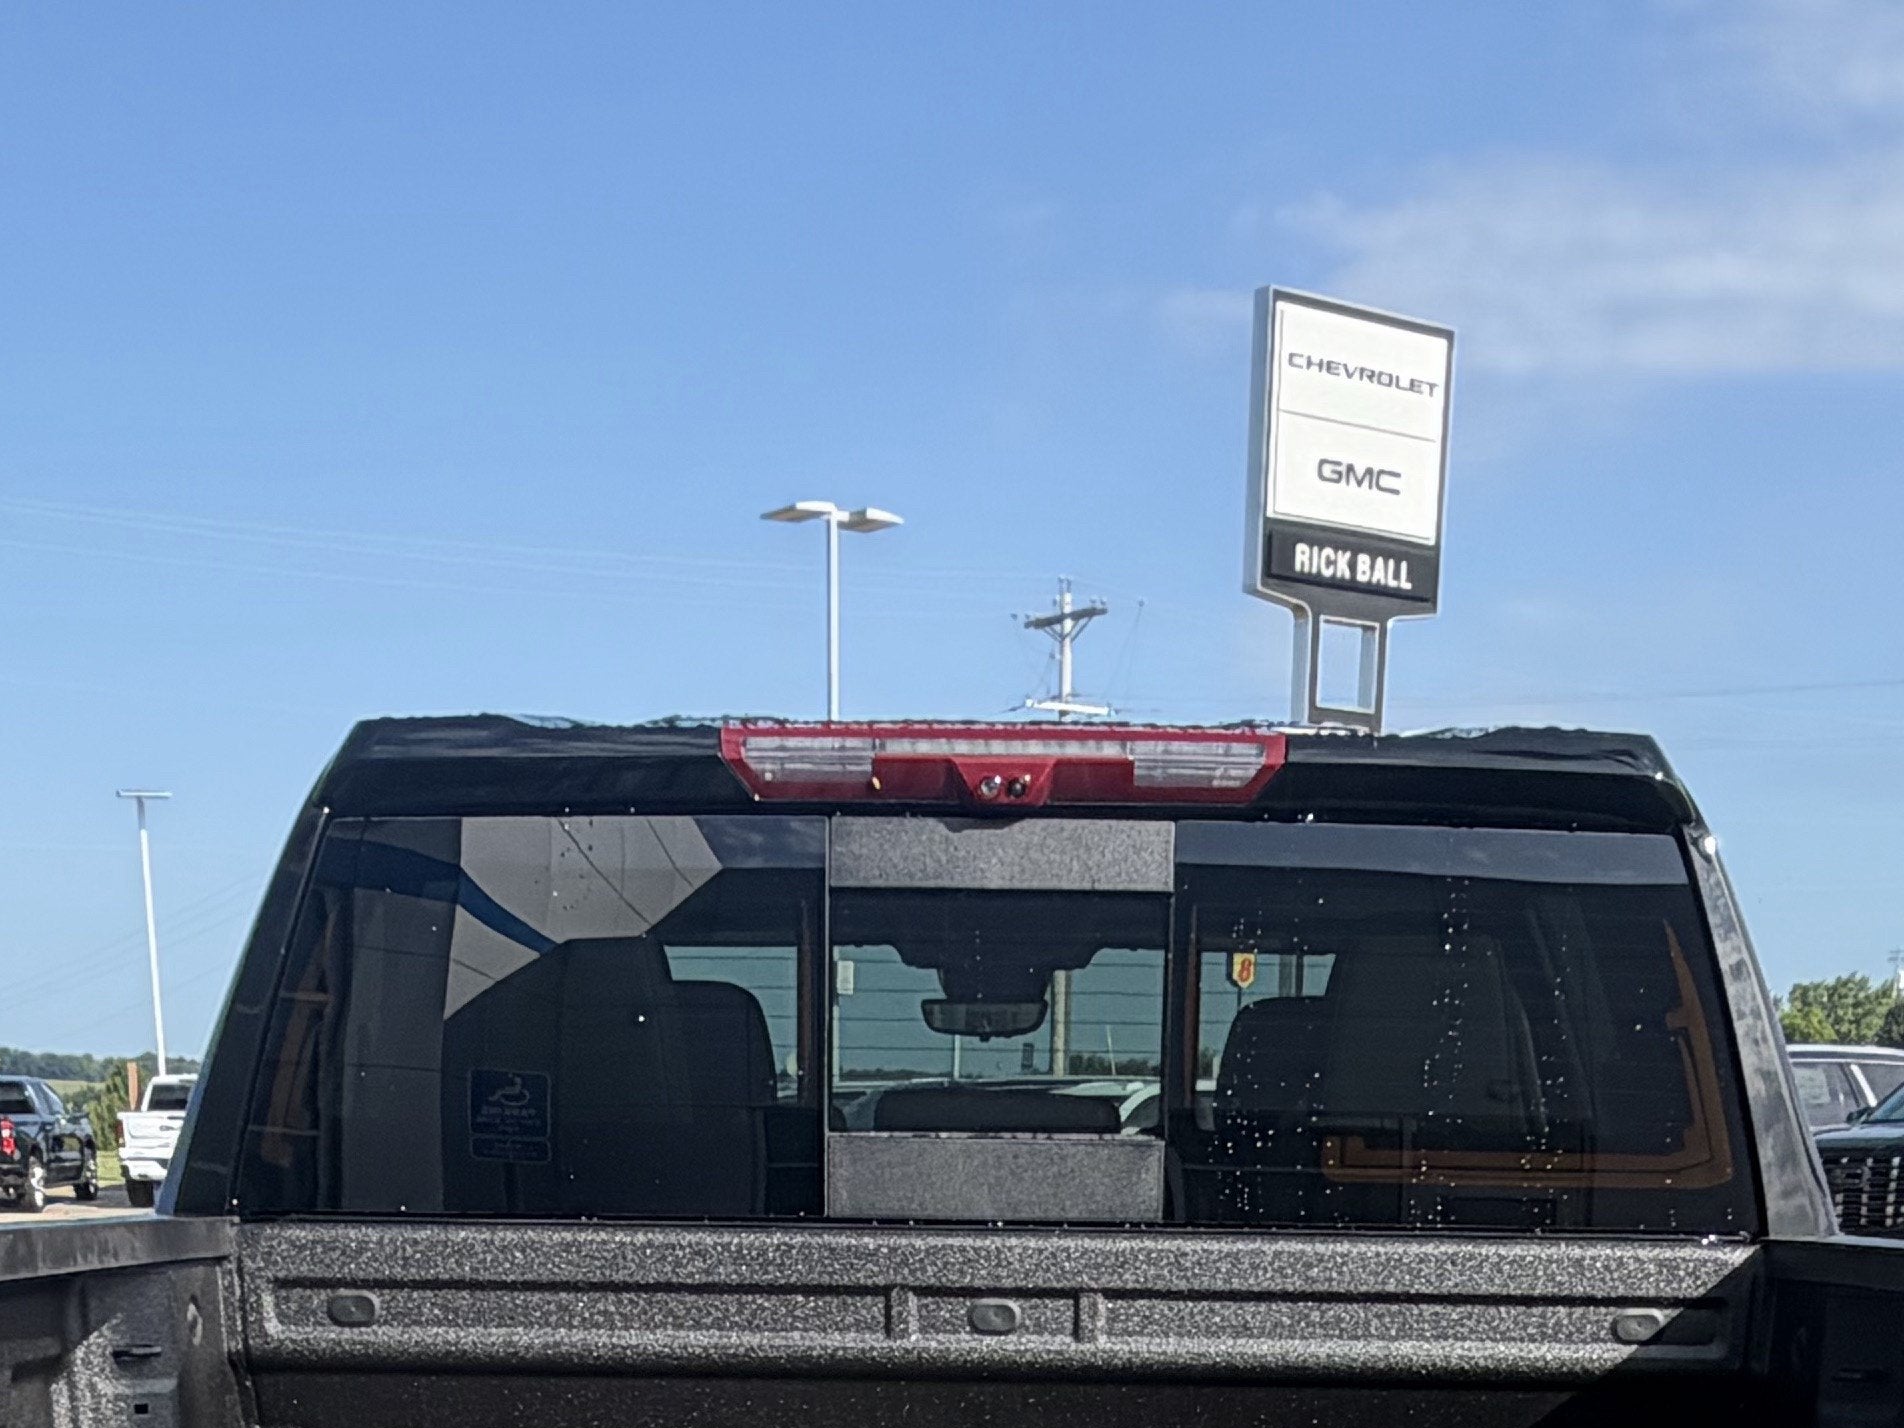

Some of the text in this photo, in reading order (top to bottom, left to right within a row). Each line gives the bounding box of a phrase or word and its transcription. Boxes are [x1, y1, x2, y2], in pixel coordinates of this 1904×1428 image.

[1287, 352, 1439, 398] CHEVROLET
[1317, 458, 1401, 496] GMC
[1294, 542, 1413, 590] RICK BALL
